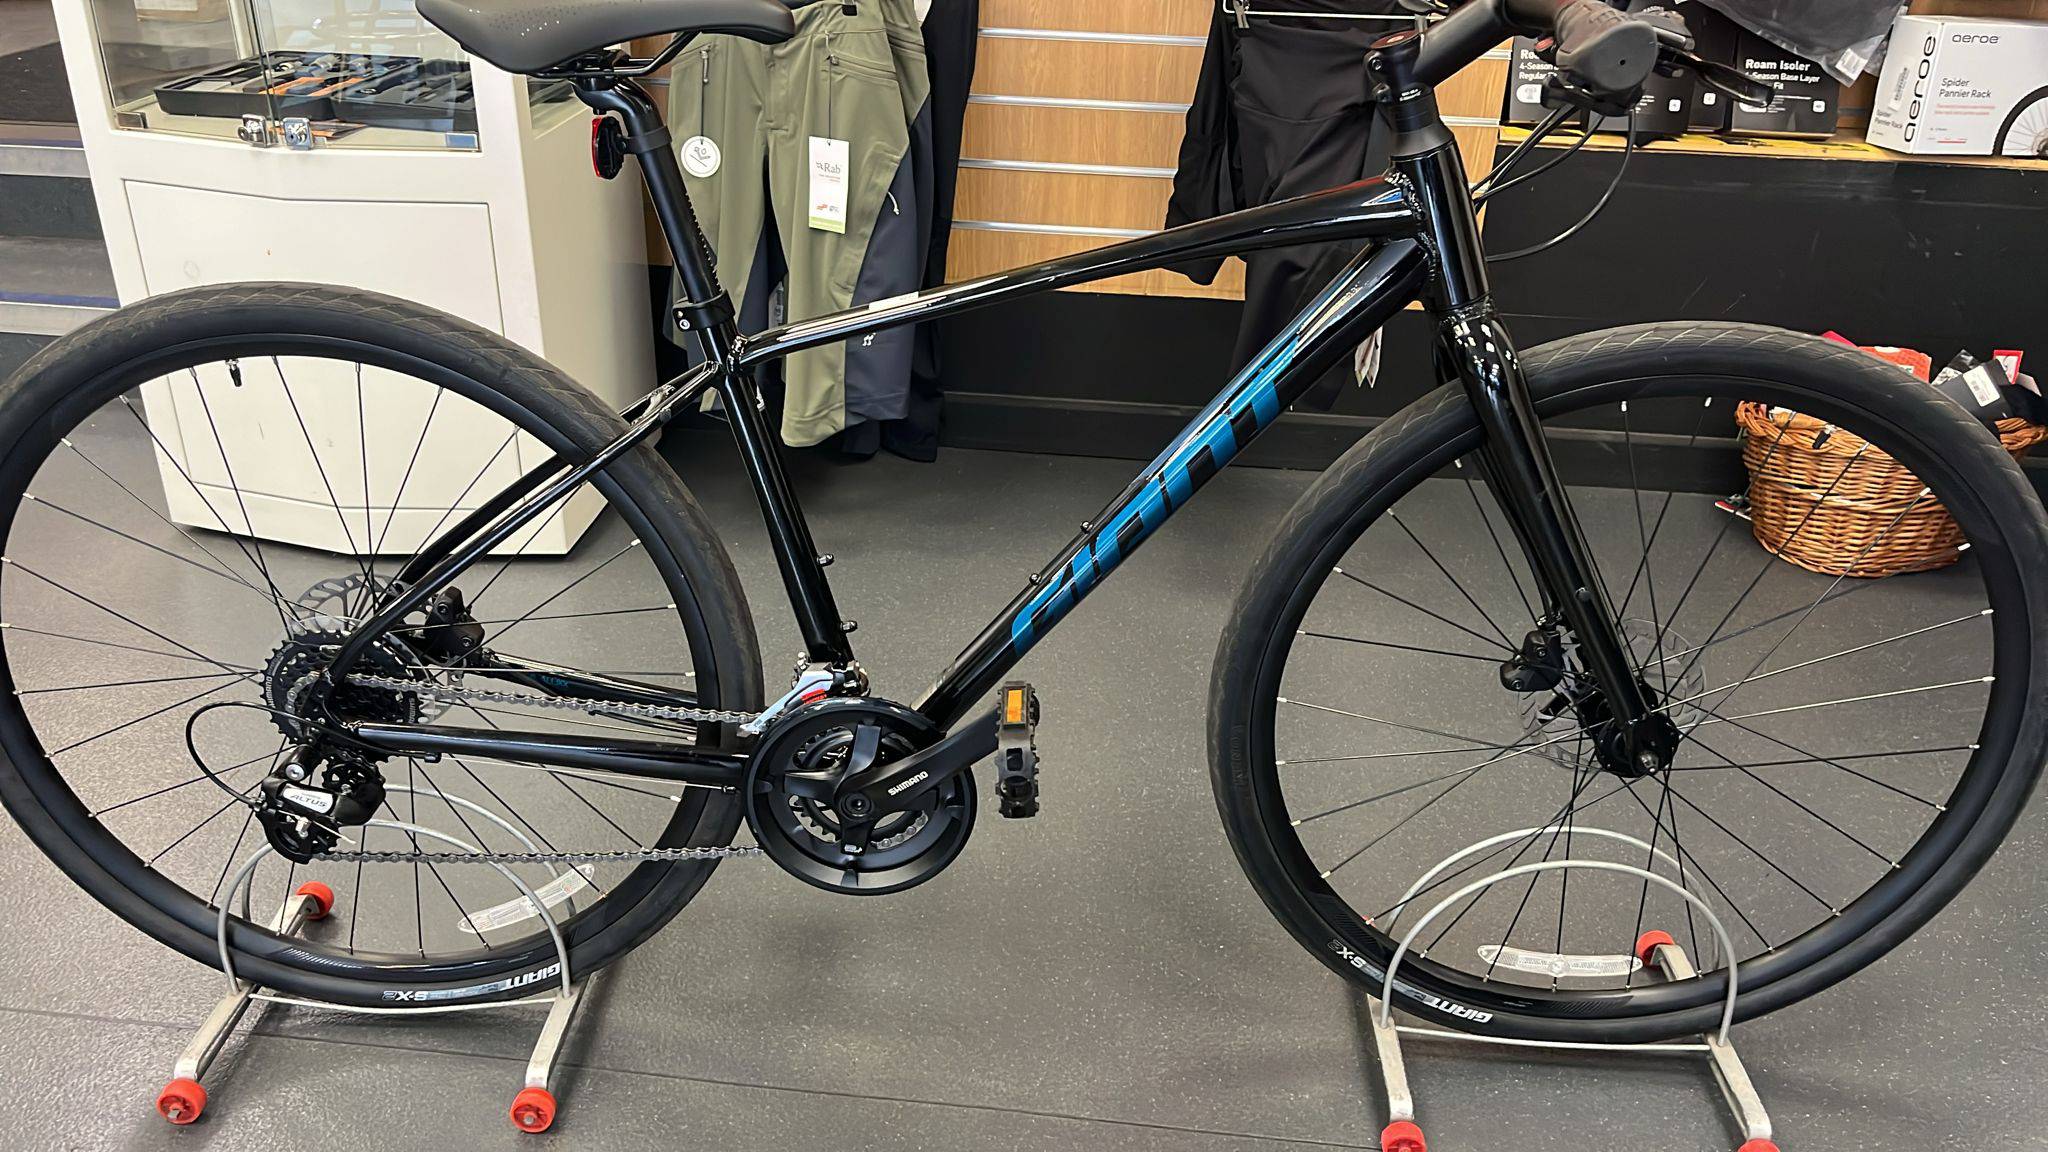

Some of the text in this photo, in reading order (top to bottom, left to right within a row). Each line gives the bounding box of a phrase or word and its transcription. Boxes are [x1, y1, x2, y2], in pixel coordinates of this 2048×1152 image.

[1952, 33, 1999, 44] aeroe
[1519, 62, 1553, 71] 4-Season
[1745, 58, 1811, 71] Roam Isoler
[1780, 73, 1799, 81] Base
[1800, 74, 1821, 84] Layer
[1941, 77, 1970, 88] Spider
[1904, 35, 1937, 143] aeroe
[1939, 88, 1992, 99] Pannier Rack
[824, 162, 841, 174] Rab
[887, 770, 929, 796] SHIMANO
[290, 794, 328, 808] ALTUS
[499, 962, 561, 991] GIANT
[1424, 996, 1494, 1024] GIANT
